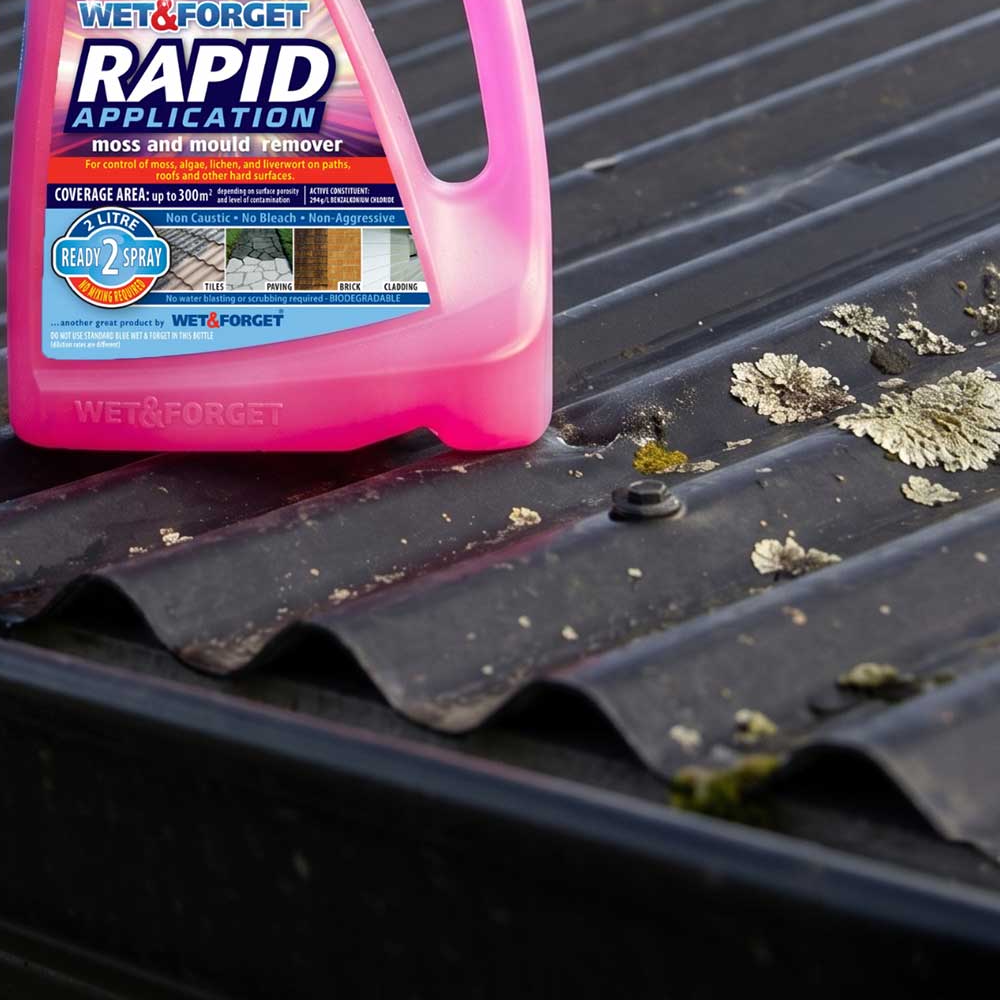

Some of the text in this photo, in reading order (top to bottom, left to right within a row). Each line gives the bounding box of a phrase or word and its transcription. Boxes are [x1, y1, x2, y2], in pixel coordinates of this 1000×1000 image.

[77, 45, 329, 102] RAPID
[72, 107, 315, 128] APPLICATION
[92, 137, 342, 152] moss and mould remover
[86, 160, 100, 168] For
[103, 160, 137, 168] control
[140, 160, 149, 168] of
[180, 160, 207, 170] algae,
[210, 160, 245, 169] lichen,
[248, 160, 261, 168] and
[264, 160, 305, 168] liverwort
[322, 160, 351, 170] paths,
[156, 171, 295, 180] roofs and other hard surfaces.
[55, 188, 113, 202] COVERAGE
[116, 188, 149, 202] AREA:
[152, 193, 164, 205] up
[166, 191, 176, 202] to
[84, 212, 139, 231] 2 LITRE
[166, 213, 395, 226] Non Caustic No Bleach Non-Aggressive
[62, 238, 162, 275] READY 2 SPRAY
[120, 319, 152, 328] product
[155, 319, 164, 328] by
[172, 312, 283, 328] WET&FORGET
[75, 396, 283, 428] WET&FORGET
